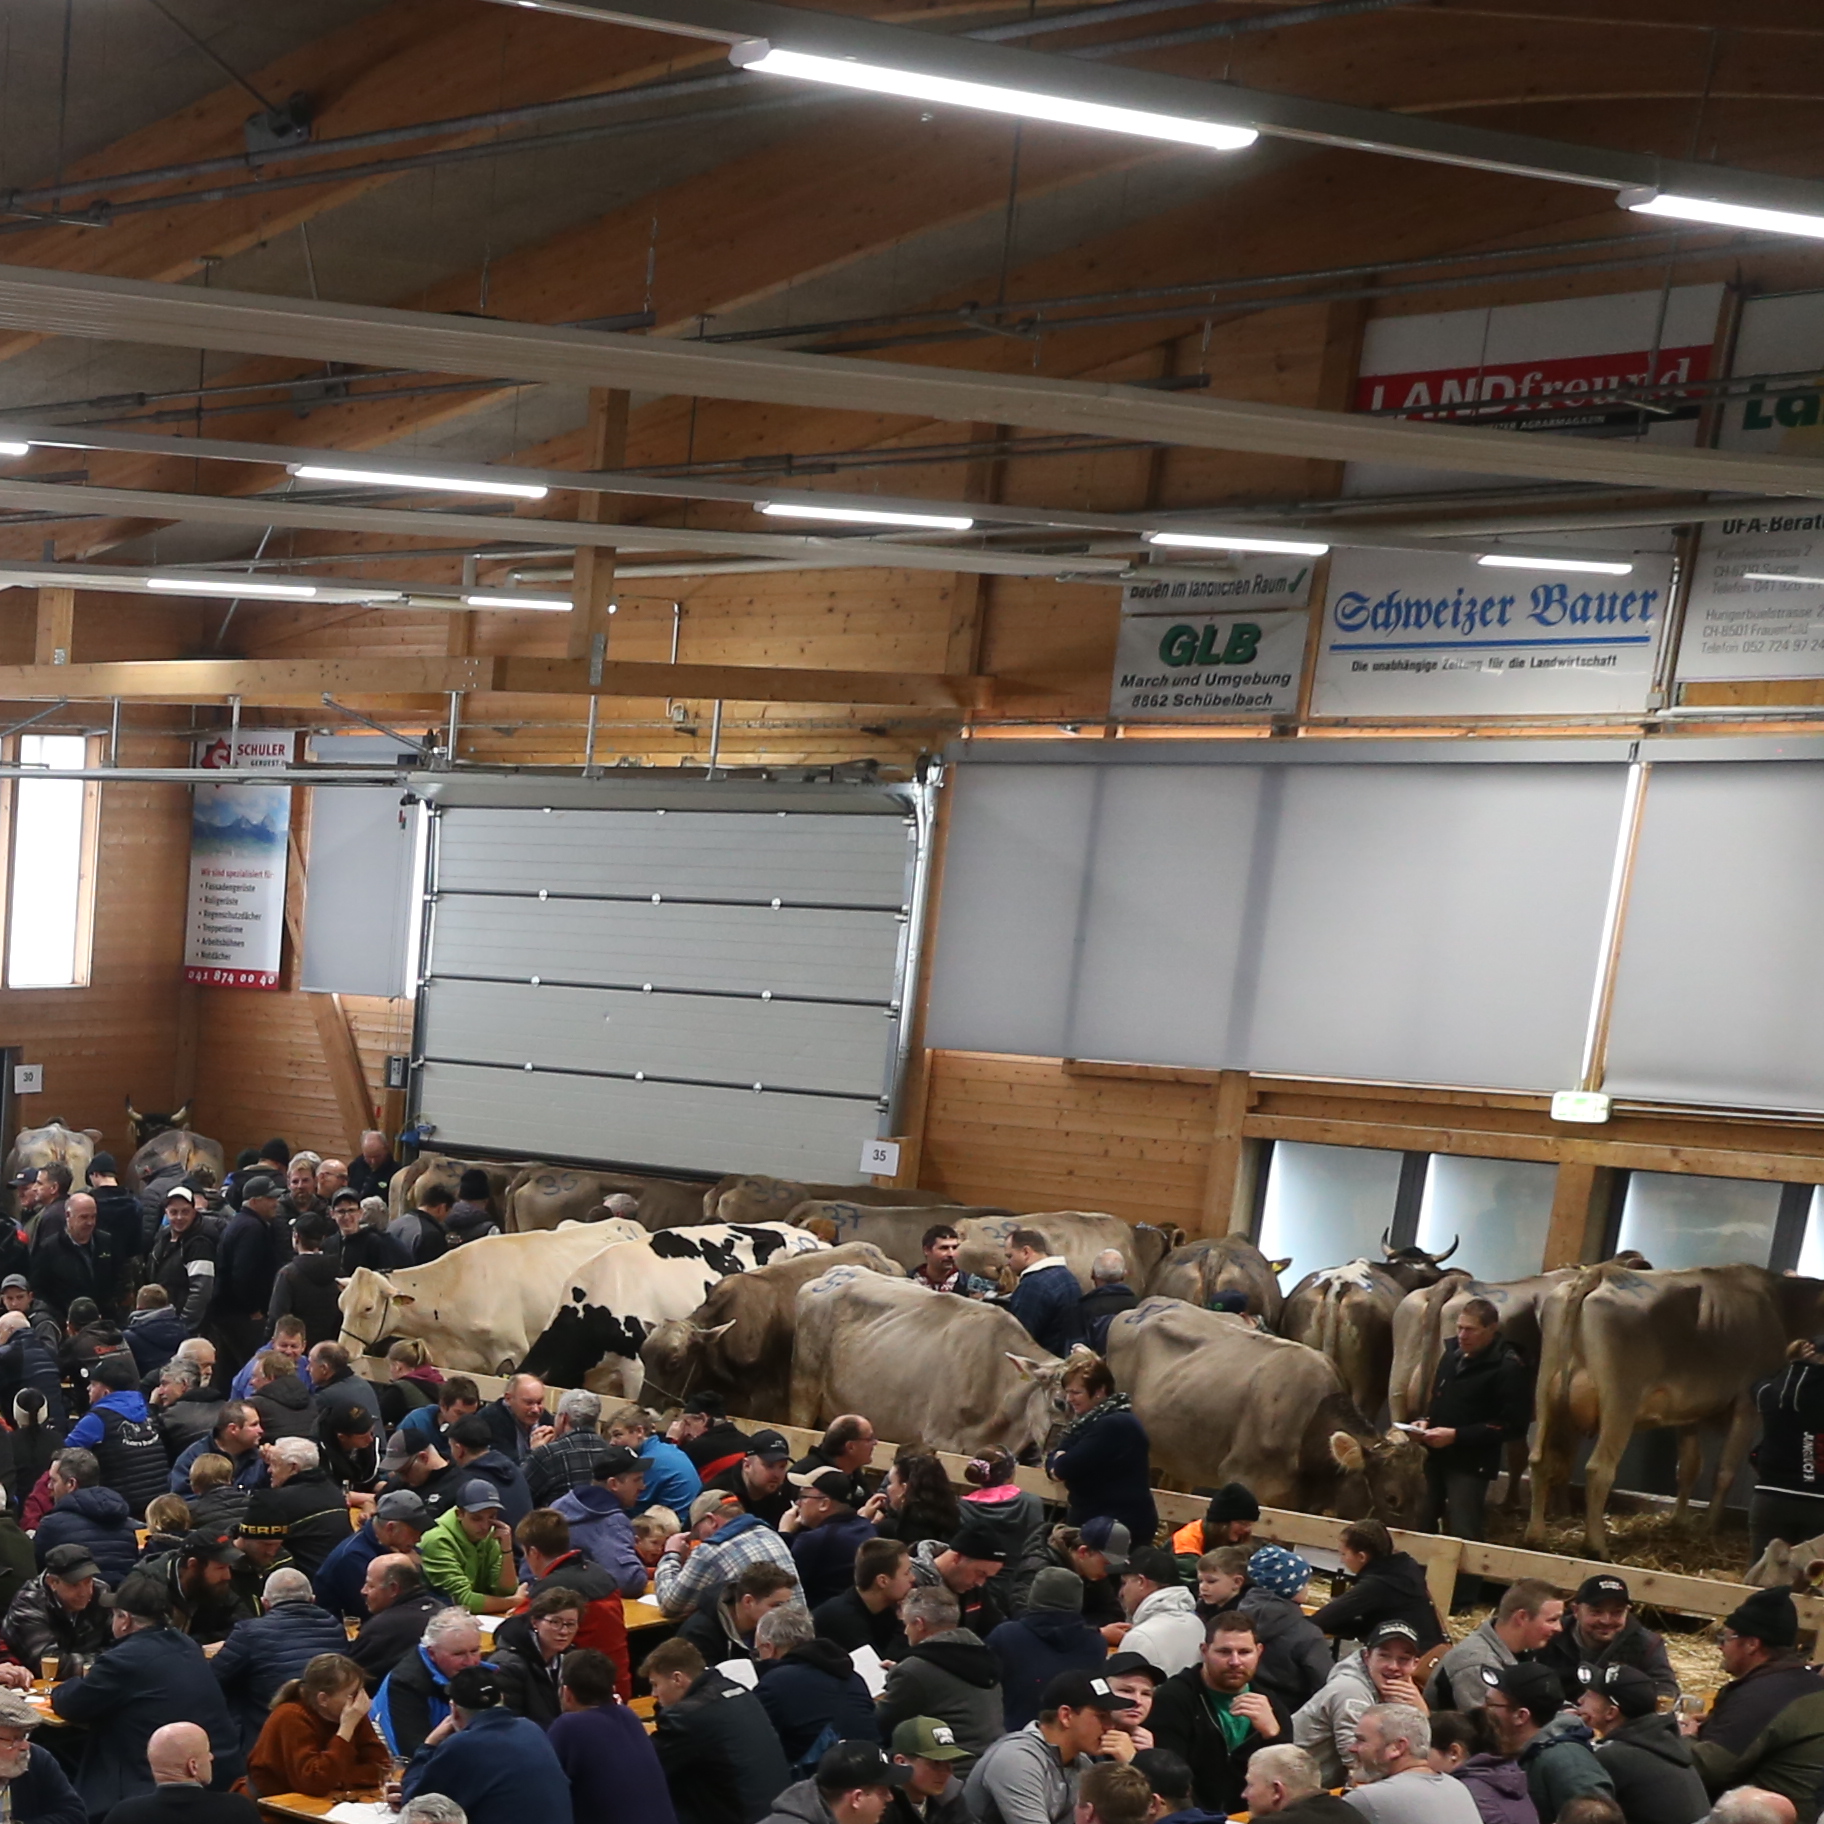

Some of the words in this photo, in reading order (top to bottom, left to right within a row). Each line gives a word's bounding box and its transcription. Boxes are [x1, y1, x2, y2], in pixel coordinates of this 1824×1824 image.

[1251, 573, 1288, 595] Raum
[1333, 586, 1516, 638] Schweizer
[1526, 582, 1658, 628] Bauer
[1158, 622, 1263, 668] GLB
[1351, 660, 1369, 673] Die
[1372, 658, 1438, 674] unabhängige
[1488, 656, 1504, 670] für
[1508, 655, 1525, 669] die
[1529, 654, 1619, 670] Landwirtschaft
[1120, 672, 1169, 688] March
[1171, 673, 1202, 688] und
[1204, 672, 1292, 689] Umgebung
[1131, 693, 1169, 708] 8862
[1172, 692, 1274, 708] Schübelbach
[236, 743, 286, 756] SCHULER
[204, 881, 256, 893] Fassadengerüste
[188, 970, 208, 982] 041
[213, 969, 235, 984] 874
[239, 973, 255, 983] 00
[259, 974, 276, 987] 40
[23, 1072, 35, 1084] 30
[872, 1148, 887, 1162] 35
[535, 1171, 579, 1197] 35
